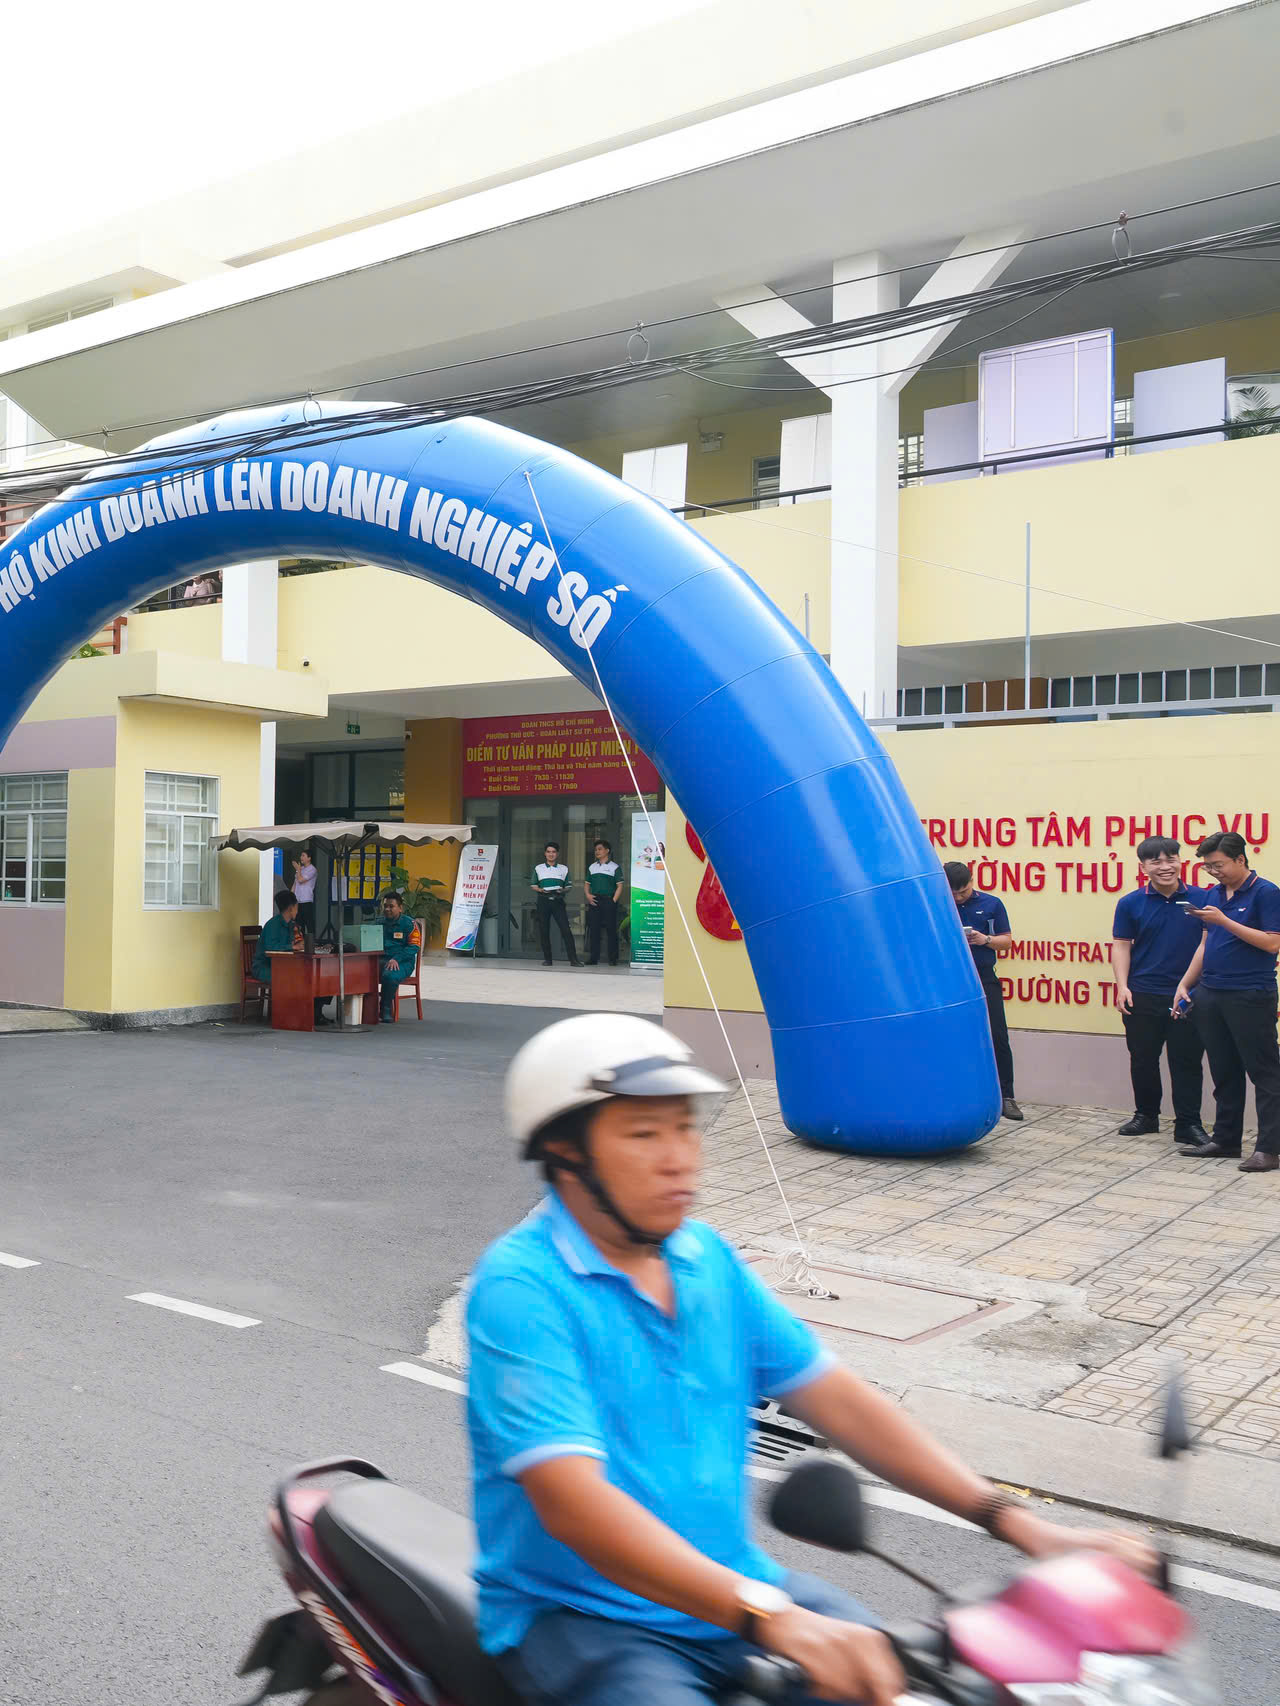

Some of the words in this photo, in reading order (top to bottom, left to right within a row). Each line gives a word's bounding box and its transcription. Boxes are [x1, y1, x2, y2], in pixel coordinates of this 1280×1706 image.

[29, 506, 102, 583] KINH
[99, 469, 209, 543] DOANH
[213, 457, 274, 512] LÊN
[279, 461, 409, 532] DOANH
[408, 486, 557, 596] NGHIỆP
[546, 570, 631, 650] SỐ
[466, 740, 493, 762] ĐIỂM
[496, 743, 511, 761] TƯ
[511, 739, 535, 760] VẤN
[536, 740, 567, 759] PHÁP
[570, 738, 597, 761] LUẬT
[920, 817, 1017, 848] RUNG
[1026, 811, 1091, 848] TÂM
[1217, 813, 1269, 854] VỤ
[1055, 852, 1123, 893] THỦ
[999, 973, 1091, 1005] ĐƯỜNG
